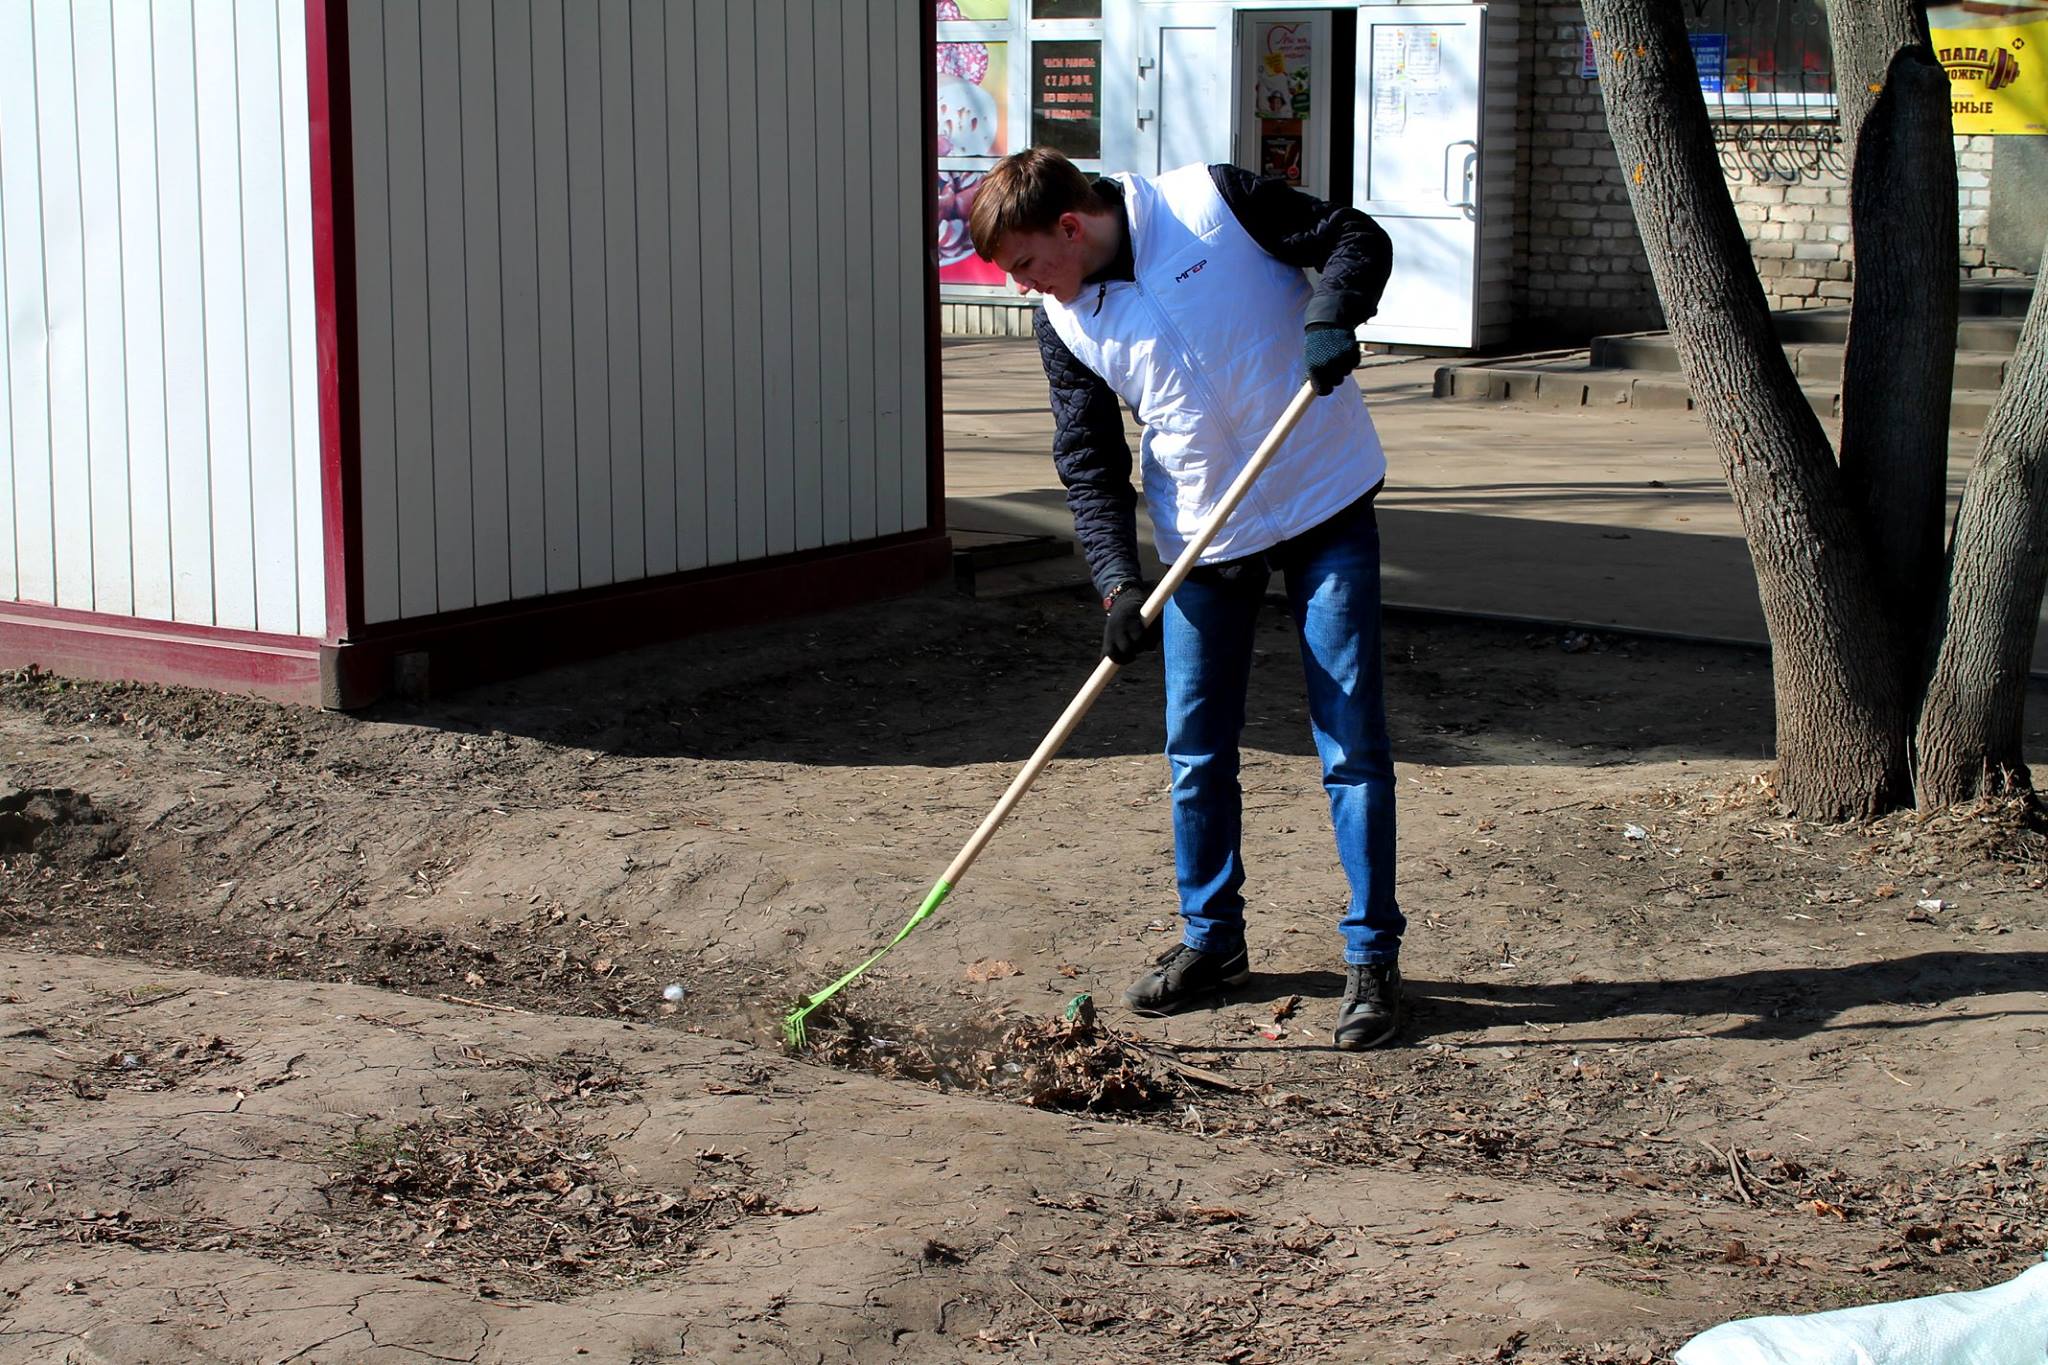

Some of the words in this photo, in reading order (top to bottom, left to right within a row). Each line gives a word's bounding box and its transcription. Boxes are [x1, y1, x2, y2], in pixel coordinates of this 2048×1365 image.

[1939, 47, 1988, 62] ПАПА
[1044, 75, 1051, 87] С
[1058, 75, 1070, 87] ДО
